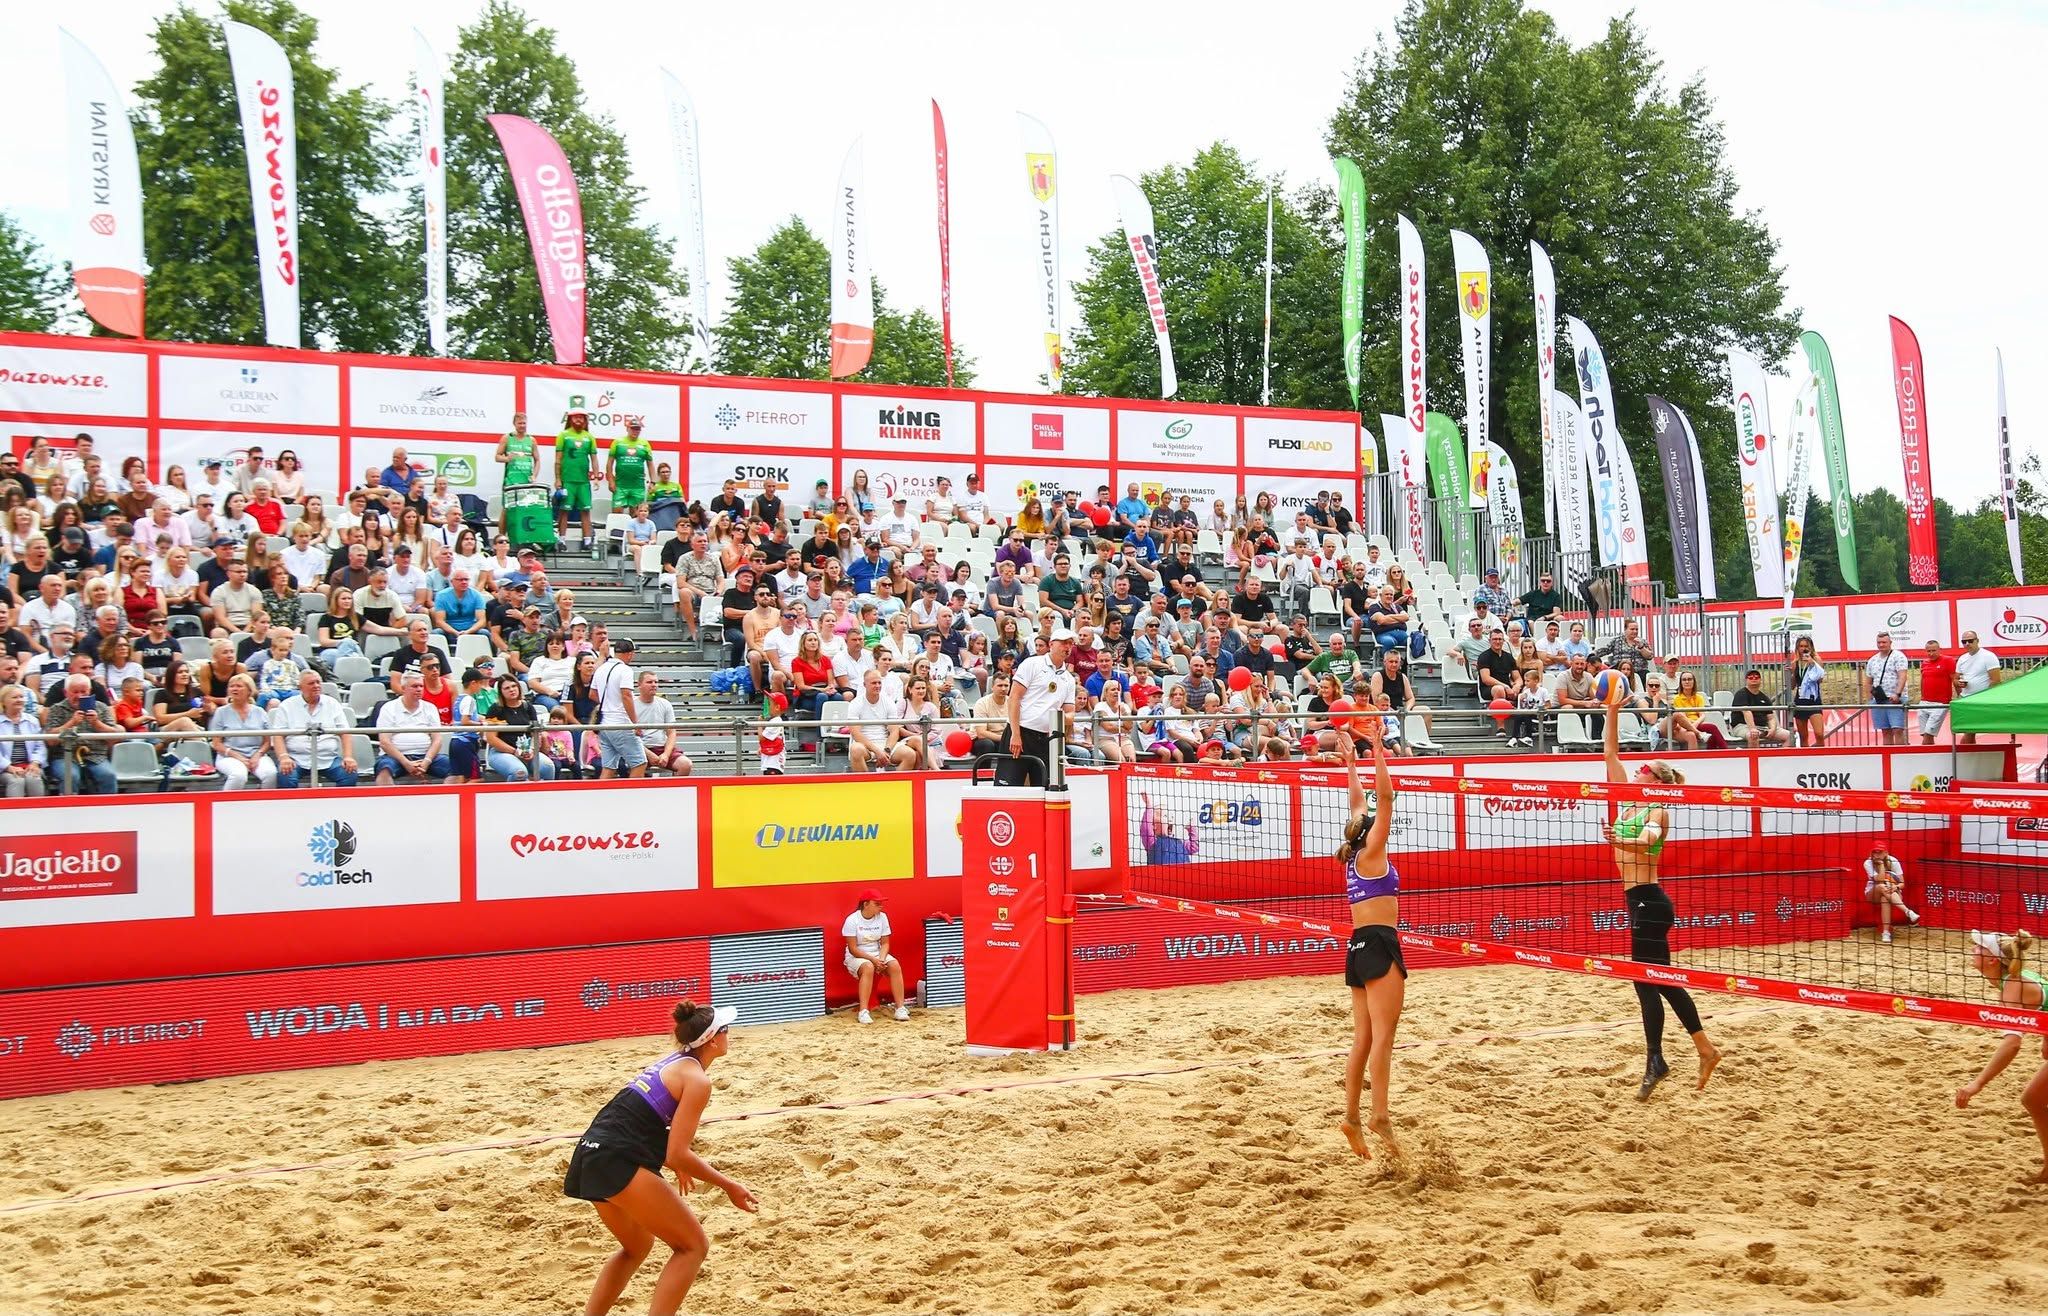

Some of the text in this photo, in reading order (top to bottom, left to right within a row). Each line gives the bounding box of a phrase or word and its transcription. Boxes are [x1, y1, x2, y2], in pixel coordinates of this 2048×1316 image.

[845, 186, 856, 273] KRYSTIAN
[220, 388, 279, 401] GUARDIAN
[230, 403, 270, 414] CLINIC
[379, 403, 418, 416] DWÓR
[746, 410, 808, 426] PIERROT
[879, 426, 941, 441] KLINKER
[1033, 423, 1055, 431] CHILL
[1172, 426, 1187, 435] SGB
[1039, 431, 1062, 439] BERRY
[1152, 441, 1168, 450] Bank
[1268, 438, 1333, 452] PLEXILAND
[735, 465, 789, 483] STORK
[1040, 481, 1060, 490] MOC
[1190, 488, 1216, 497] MIASTO
[2002, 623, 2042, 634] TOMPEX
[1797, 773, 1851, 790] STORK
[1973, 798, 2032, 810] Mazowsze.
[787, 823, 879, 844] LEWIATAN
[510, 830, 660, 859] Mazowsze.
[609, 850, 654, 861] serce Polski
[0, 849, 122, 882] Jagiełło
[1028, 852, 1037, 879] 1
[1948, 889, 2001, 905] PIERROT
[1164, 933, 1248, 960] WODA
[245, 1003, 367, 1040] WODA
[1979, 1010, 2038, 1028] Mazowsze.
[103, 1018, 207, 1046] PIERROT
